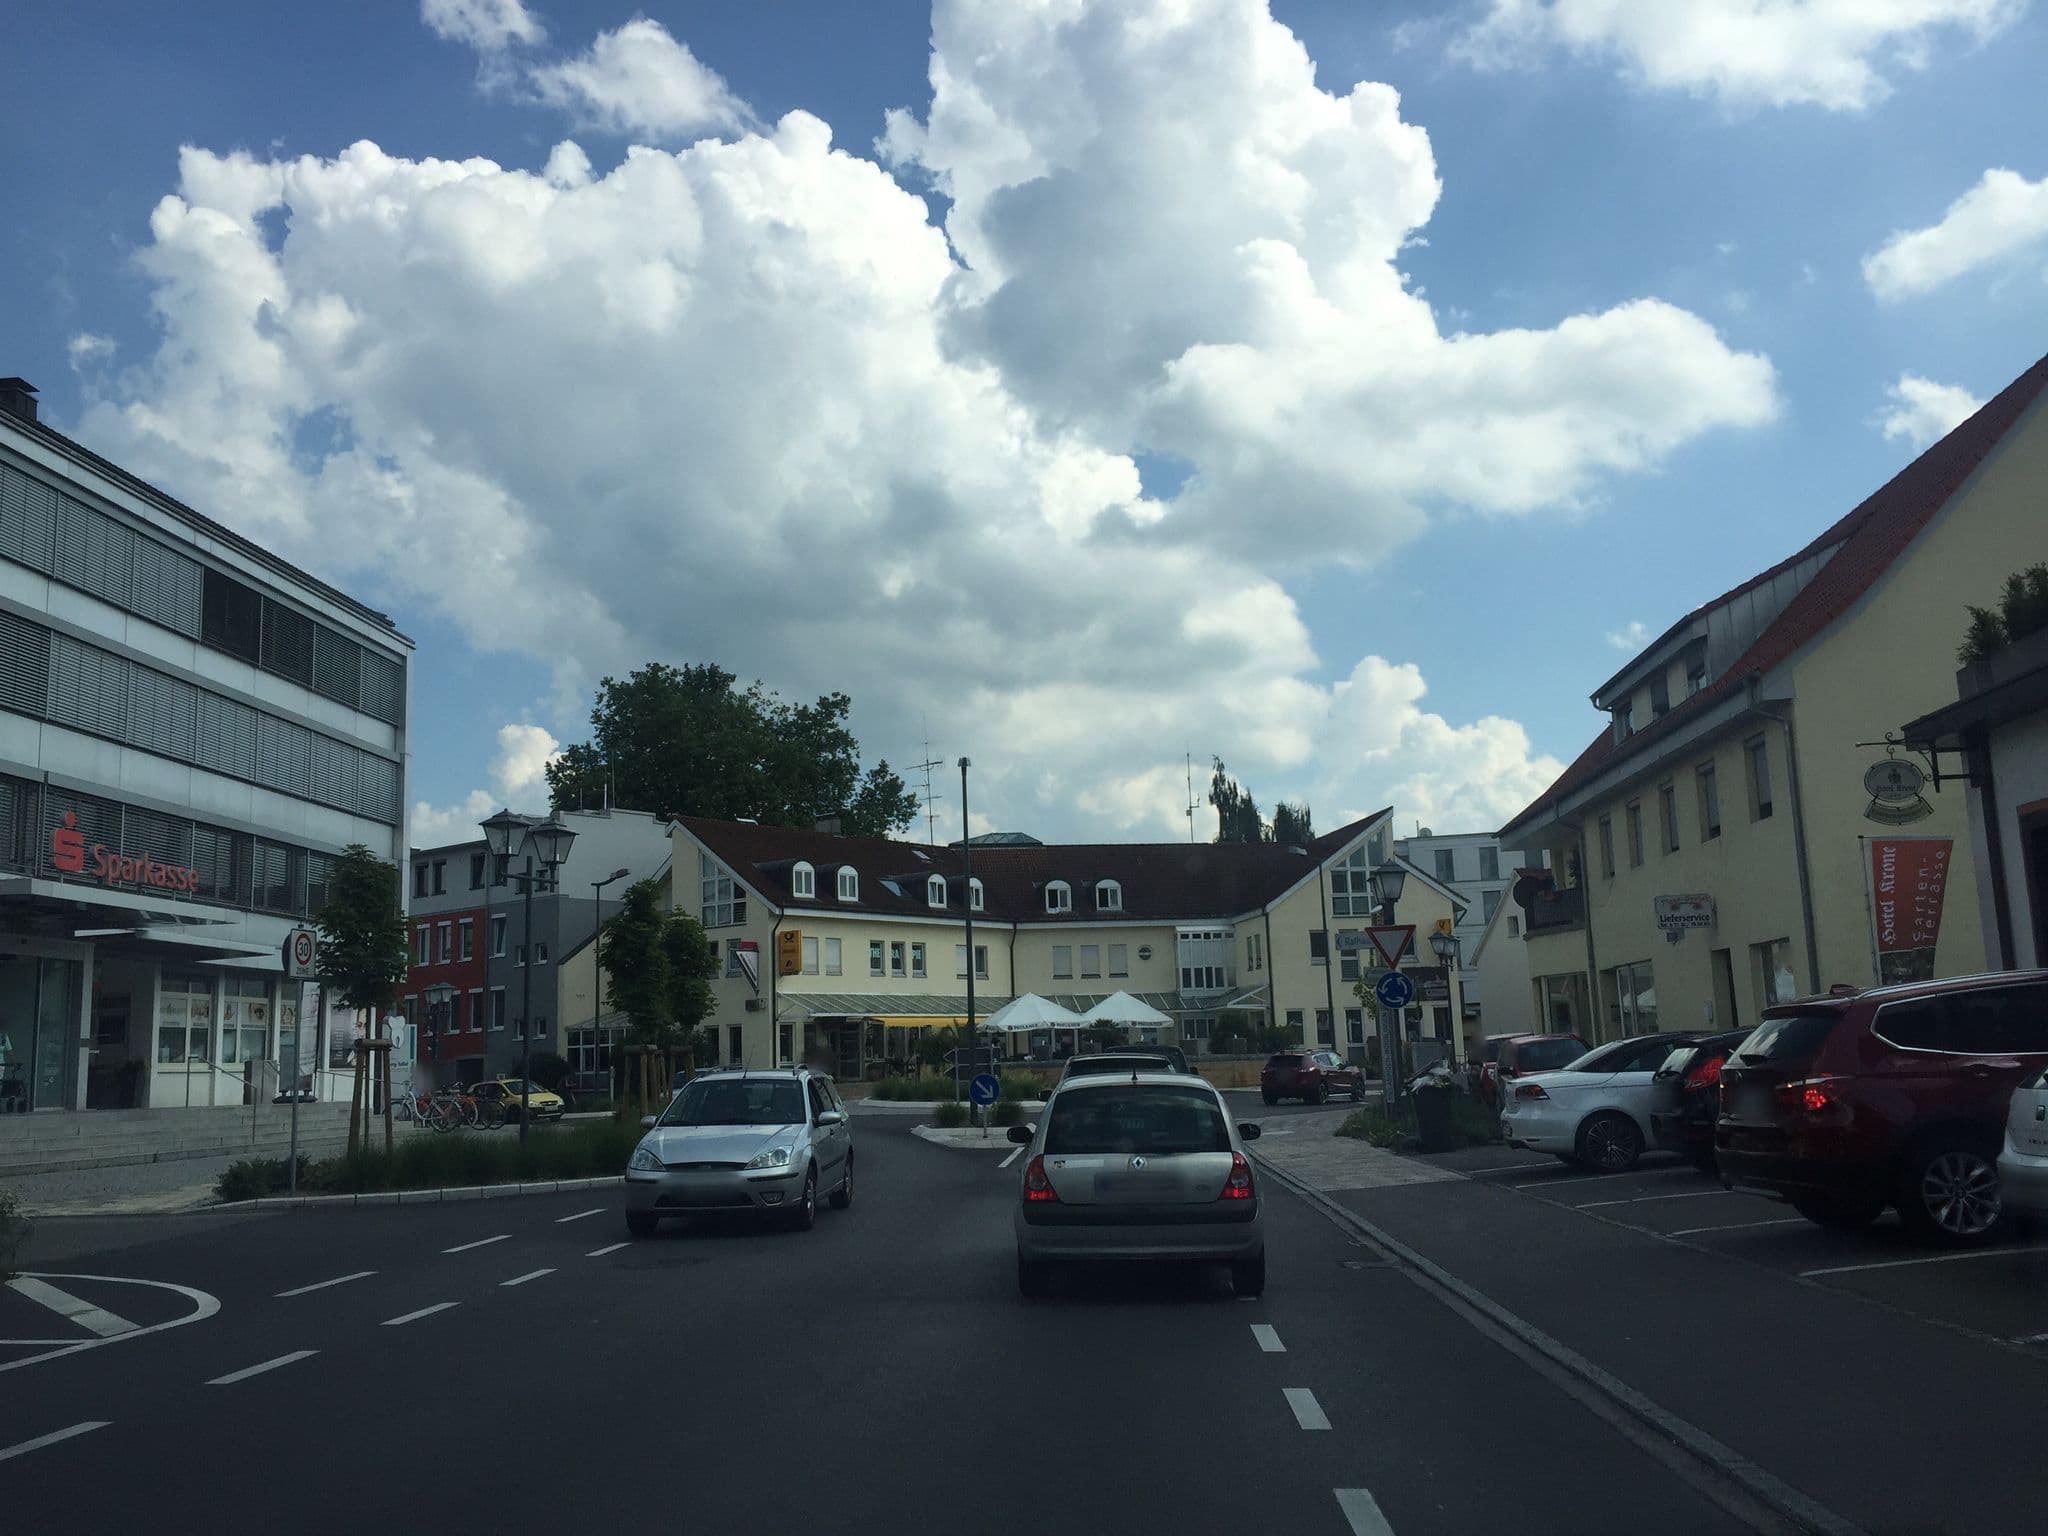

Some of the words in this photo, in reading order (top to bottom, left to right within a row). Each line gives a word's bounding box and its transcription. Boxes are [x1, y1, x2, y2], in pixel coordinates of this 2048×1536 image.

[93, 843, 200, 893] Sparkasse
[1879, 845, 1897, 893] Krone
[1659, 912, 1711, 923] Lieferservice
[1922, 849, 1947, 940] Terrasse
[1881, 900, 1897, 945] Hotel
[298, 942, 309, 957] 30
